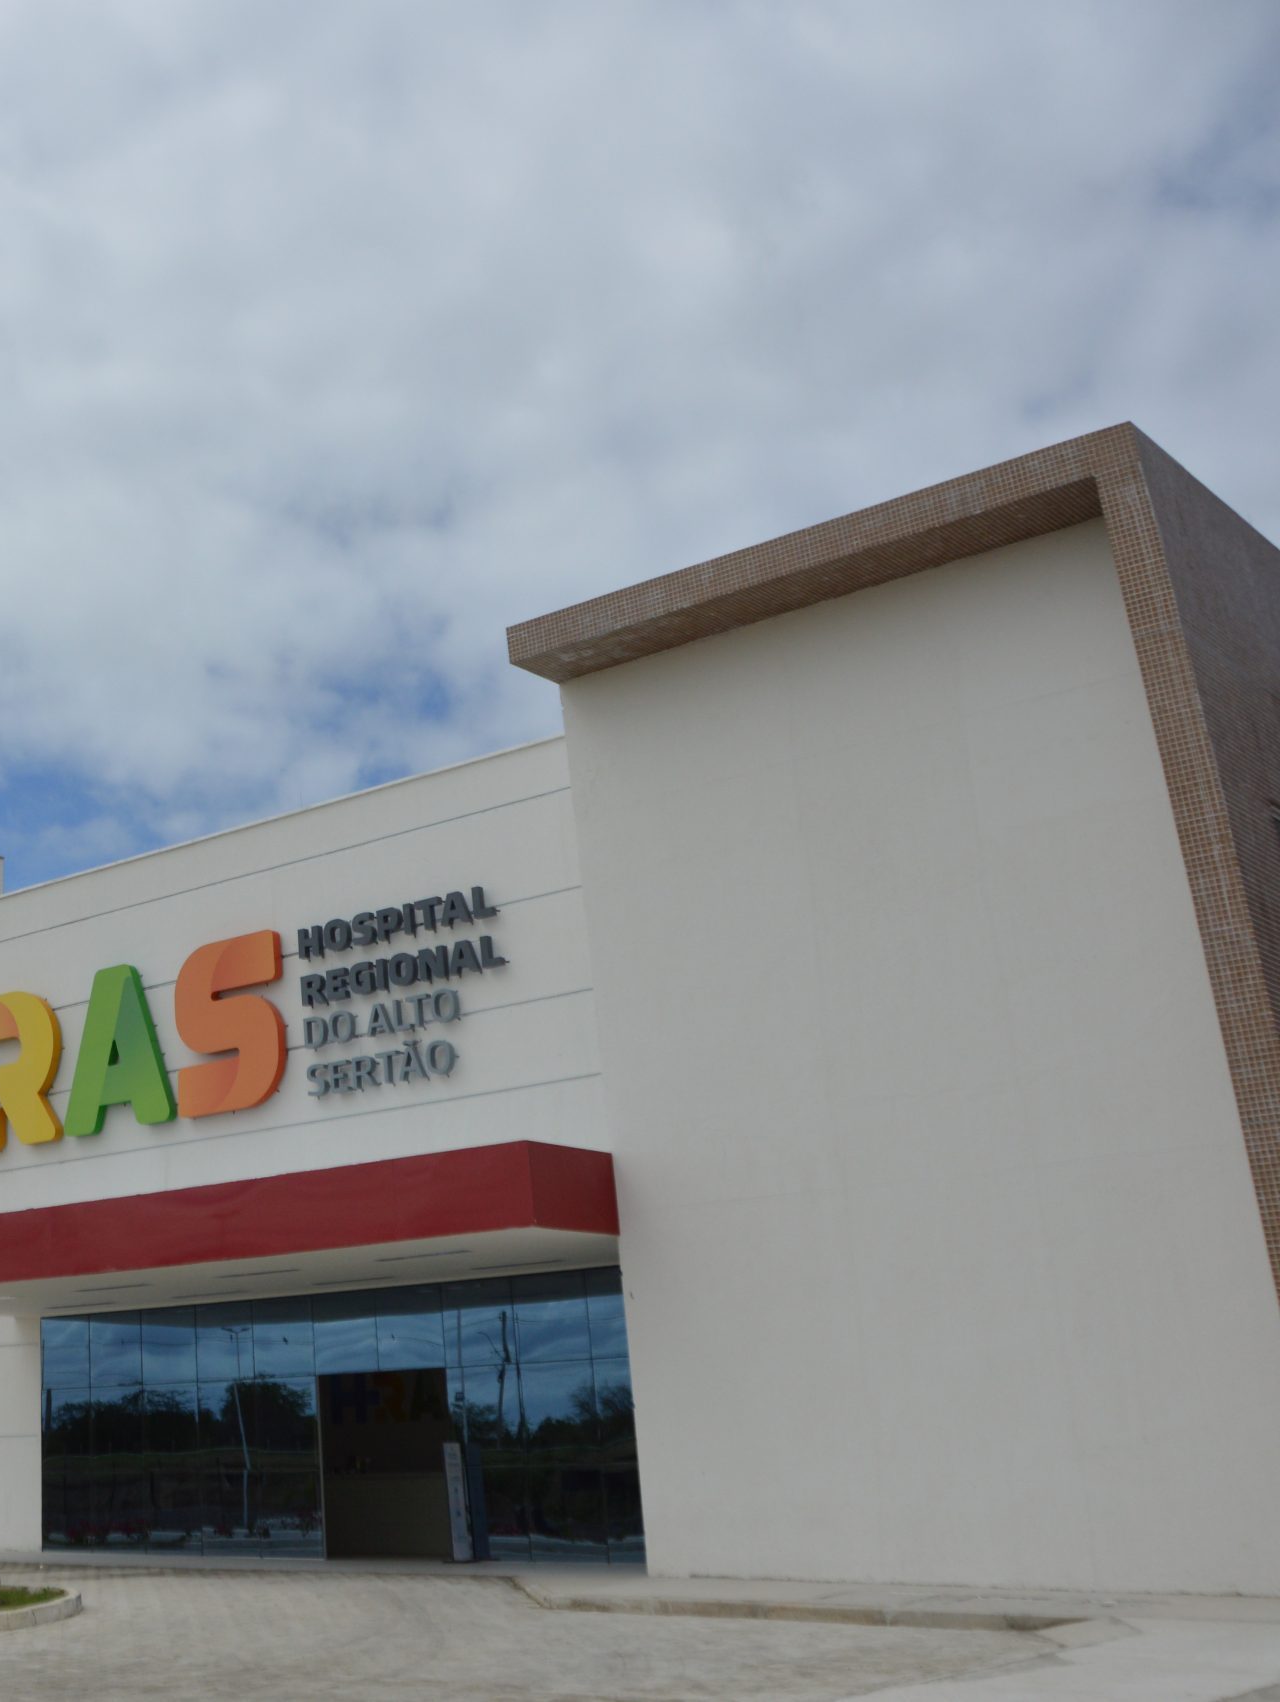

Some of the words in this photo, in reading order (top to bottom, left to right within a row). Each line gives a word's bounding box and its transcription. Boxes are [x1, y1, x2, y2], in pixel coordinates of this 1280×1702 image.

[297, 886, 498, 961] HOSPITAL
[300, 936, 507, 1007] REGIONAL
[303, 1010, 356, 1049] DO
[368, 988, 460, 1036] ALTO
[307, 1038, 457, 1098] SERTÃO
